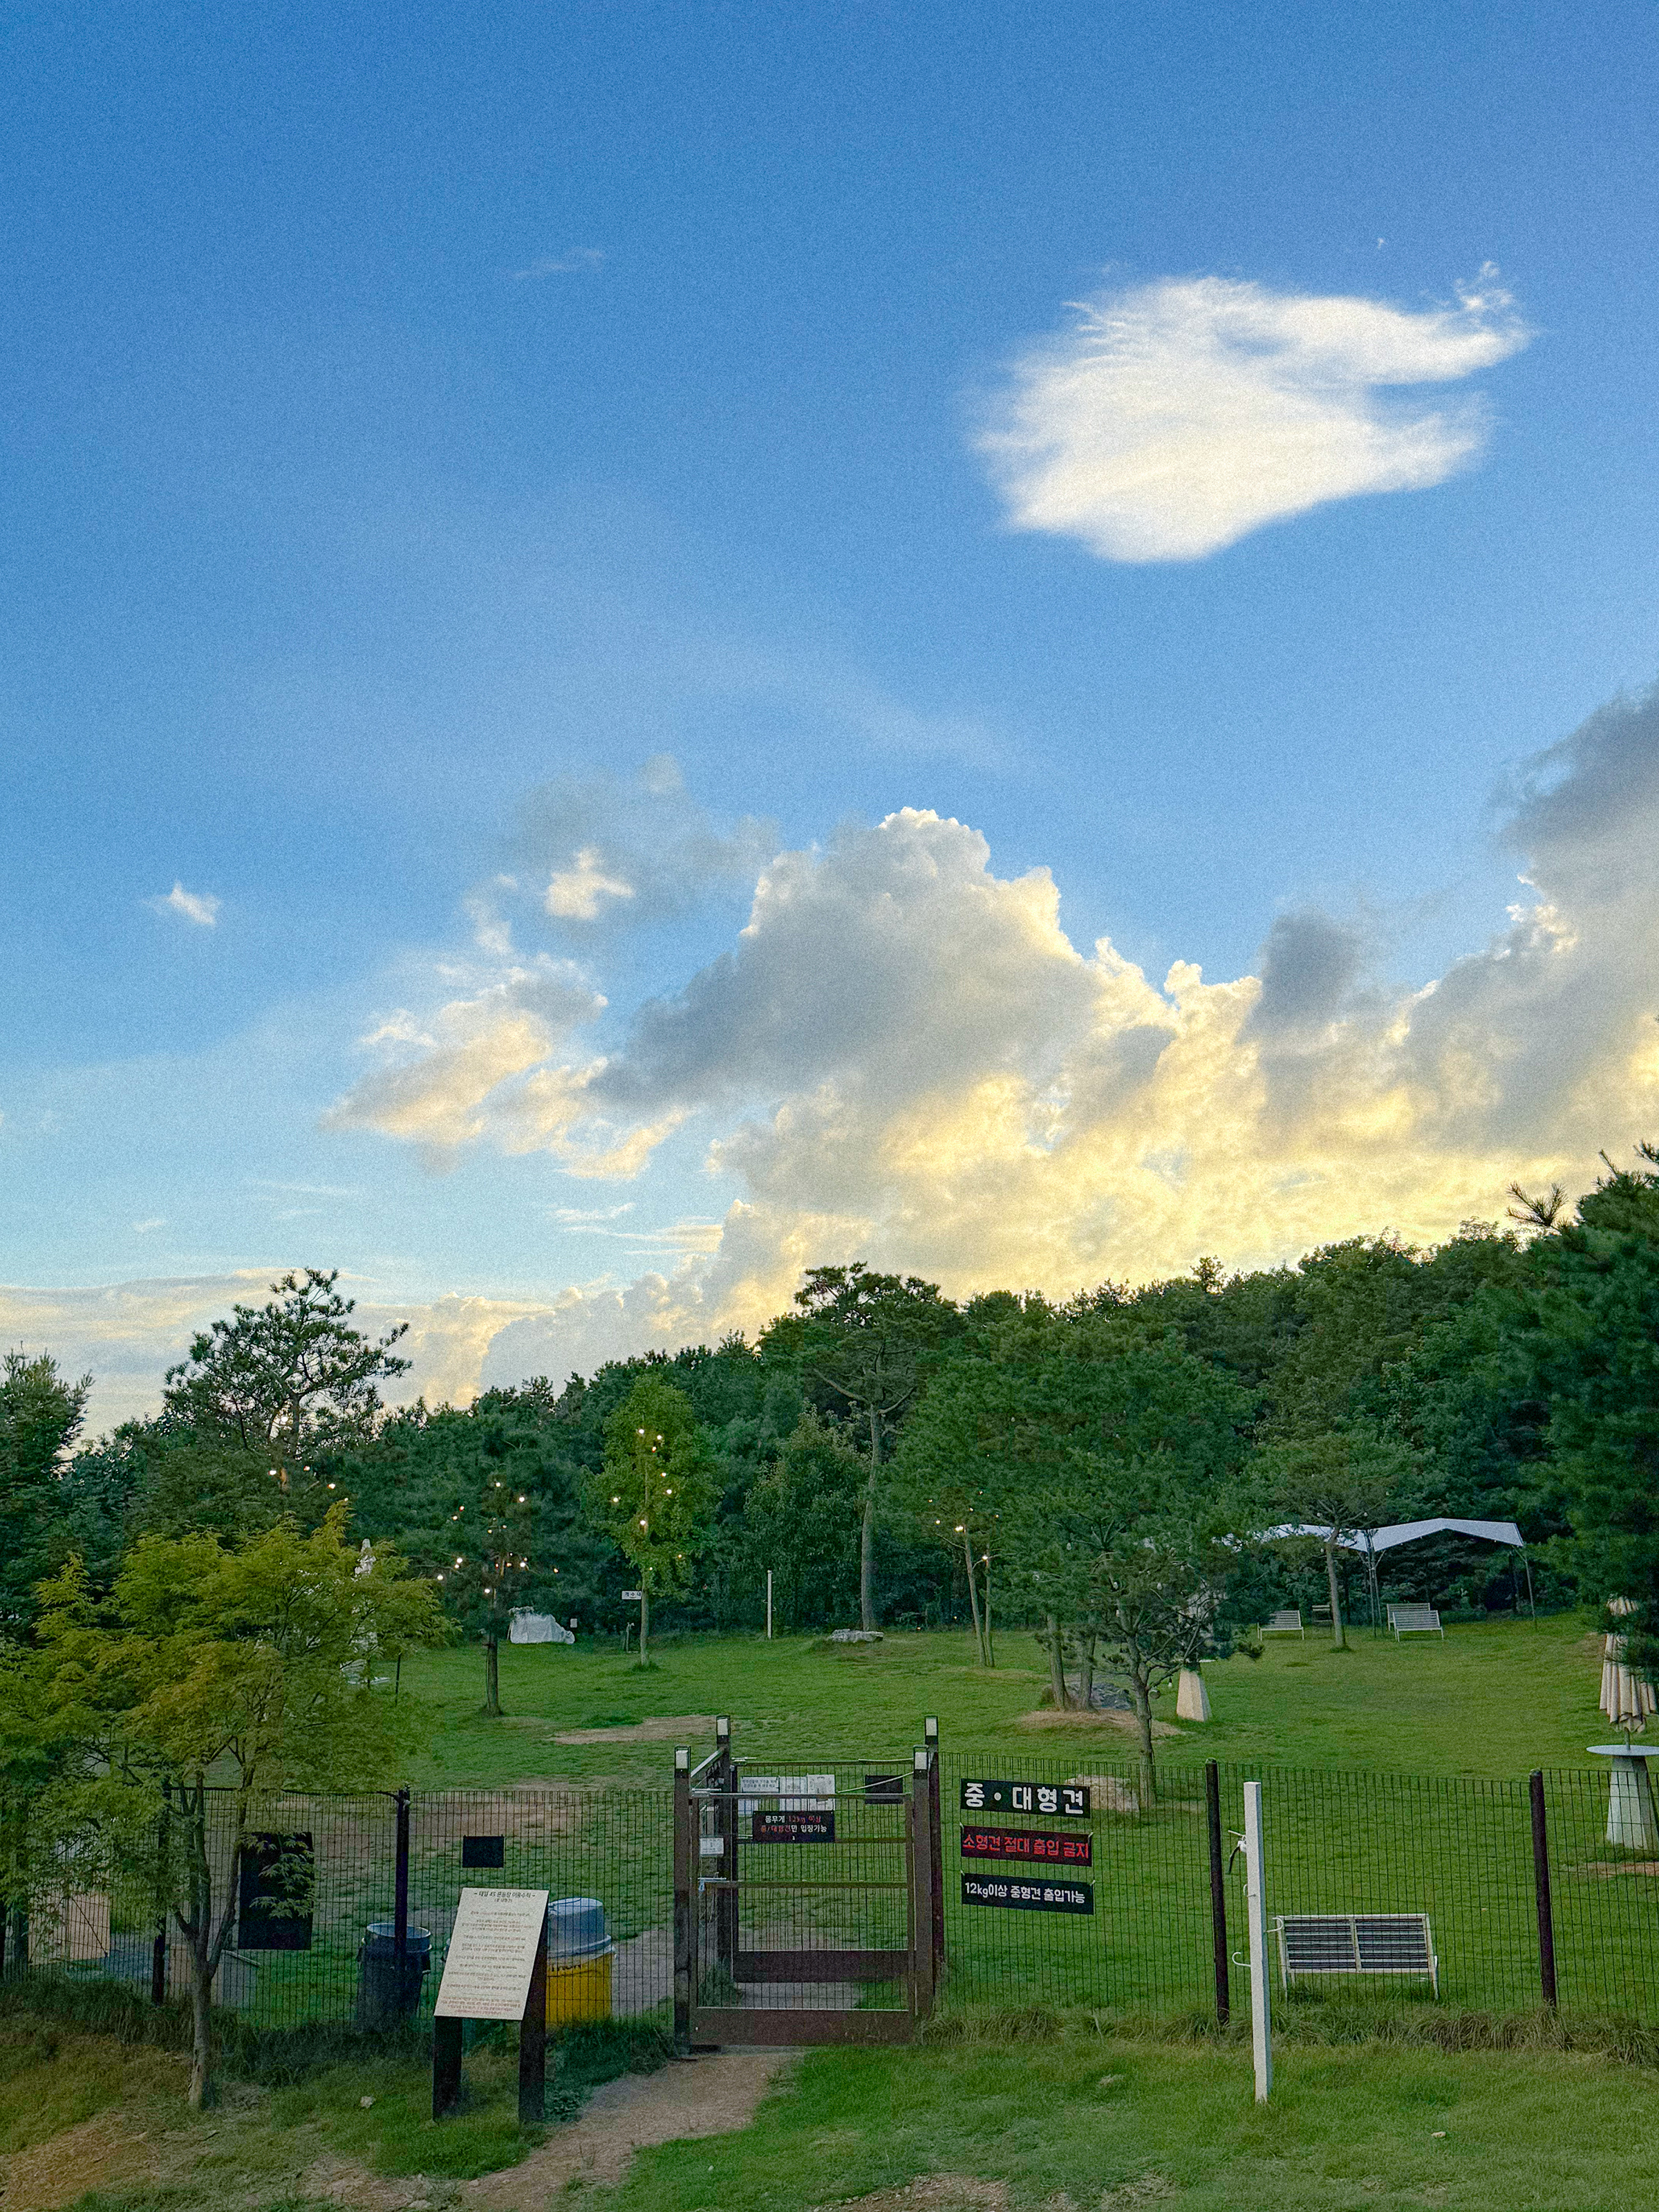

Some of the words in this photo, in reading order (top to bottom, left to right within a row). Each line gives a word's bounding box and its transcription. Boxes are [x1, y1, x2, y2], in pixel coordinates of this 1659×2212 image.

[765, 1815, 785, 1824] 몸무게
[963, 1834, 1000, 1851] 소형견
[1004, 1837, 1030, 1853] 절대
[1033, 1839, 1059, 1856] 출입
[1063, 1842, 1089, 1859] 금지
[965, 1882, 1007, 1898] 12kg이상
[1010, 1886, 1041, 1900] 중형견
[1044, 1888, 1085, 1904] 출입가능
